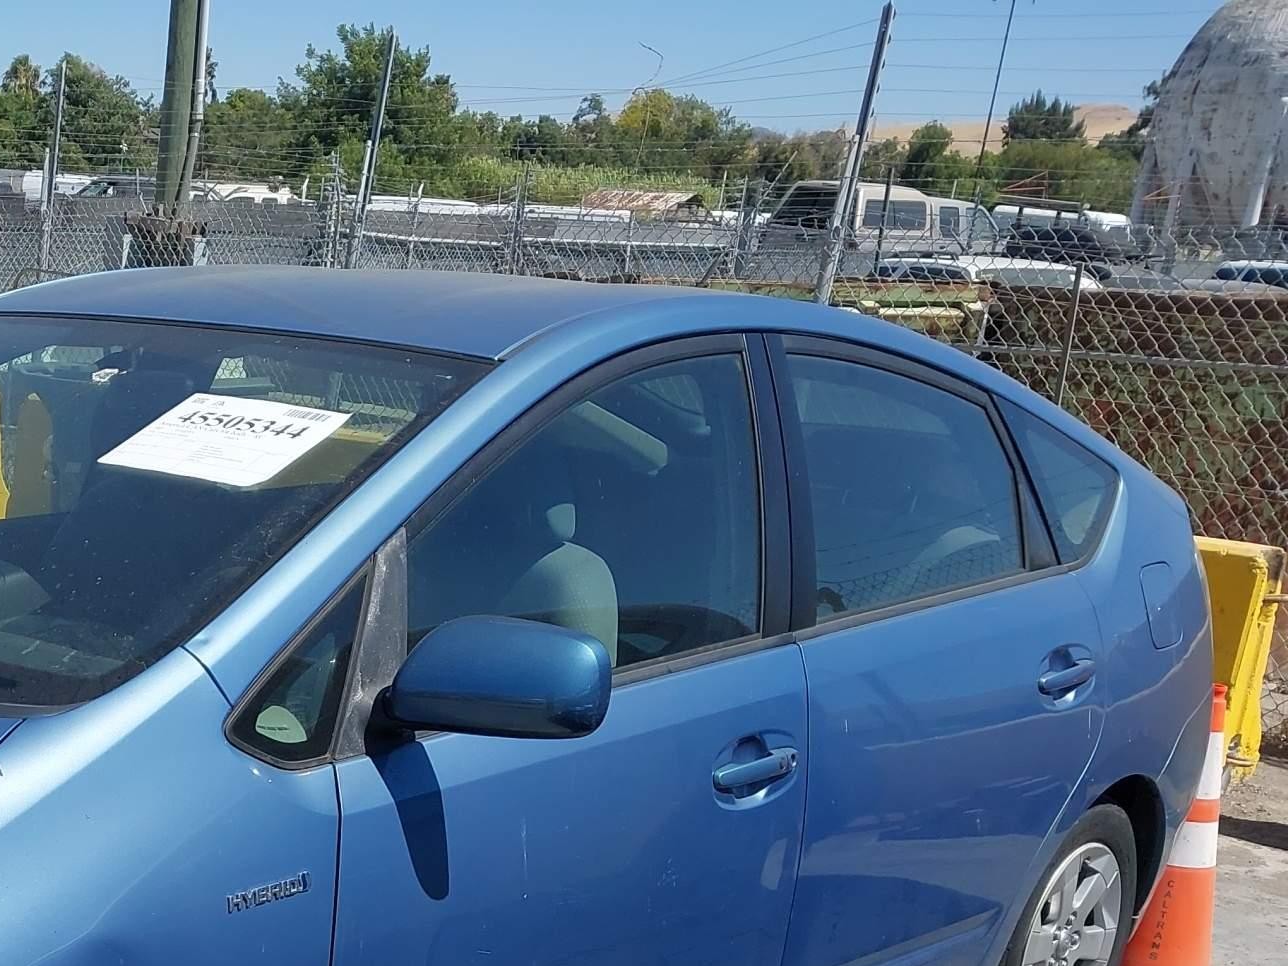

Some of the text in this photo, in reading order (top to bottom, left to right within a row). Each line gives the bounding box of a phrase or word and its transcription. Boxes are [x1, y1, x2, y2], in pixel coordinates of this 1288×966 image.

[178, 410, 311, 439] 45505344
[224, 870, 312, 914] HYBRID
[1148, 879, 1176, 961] CALTRANS
